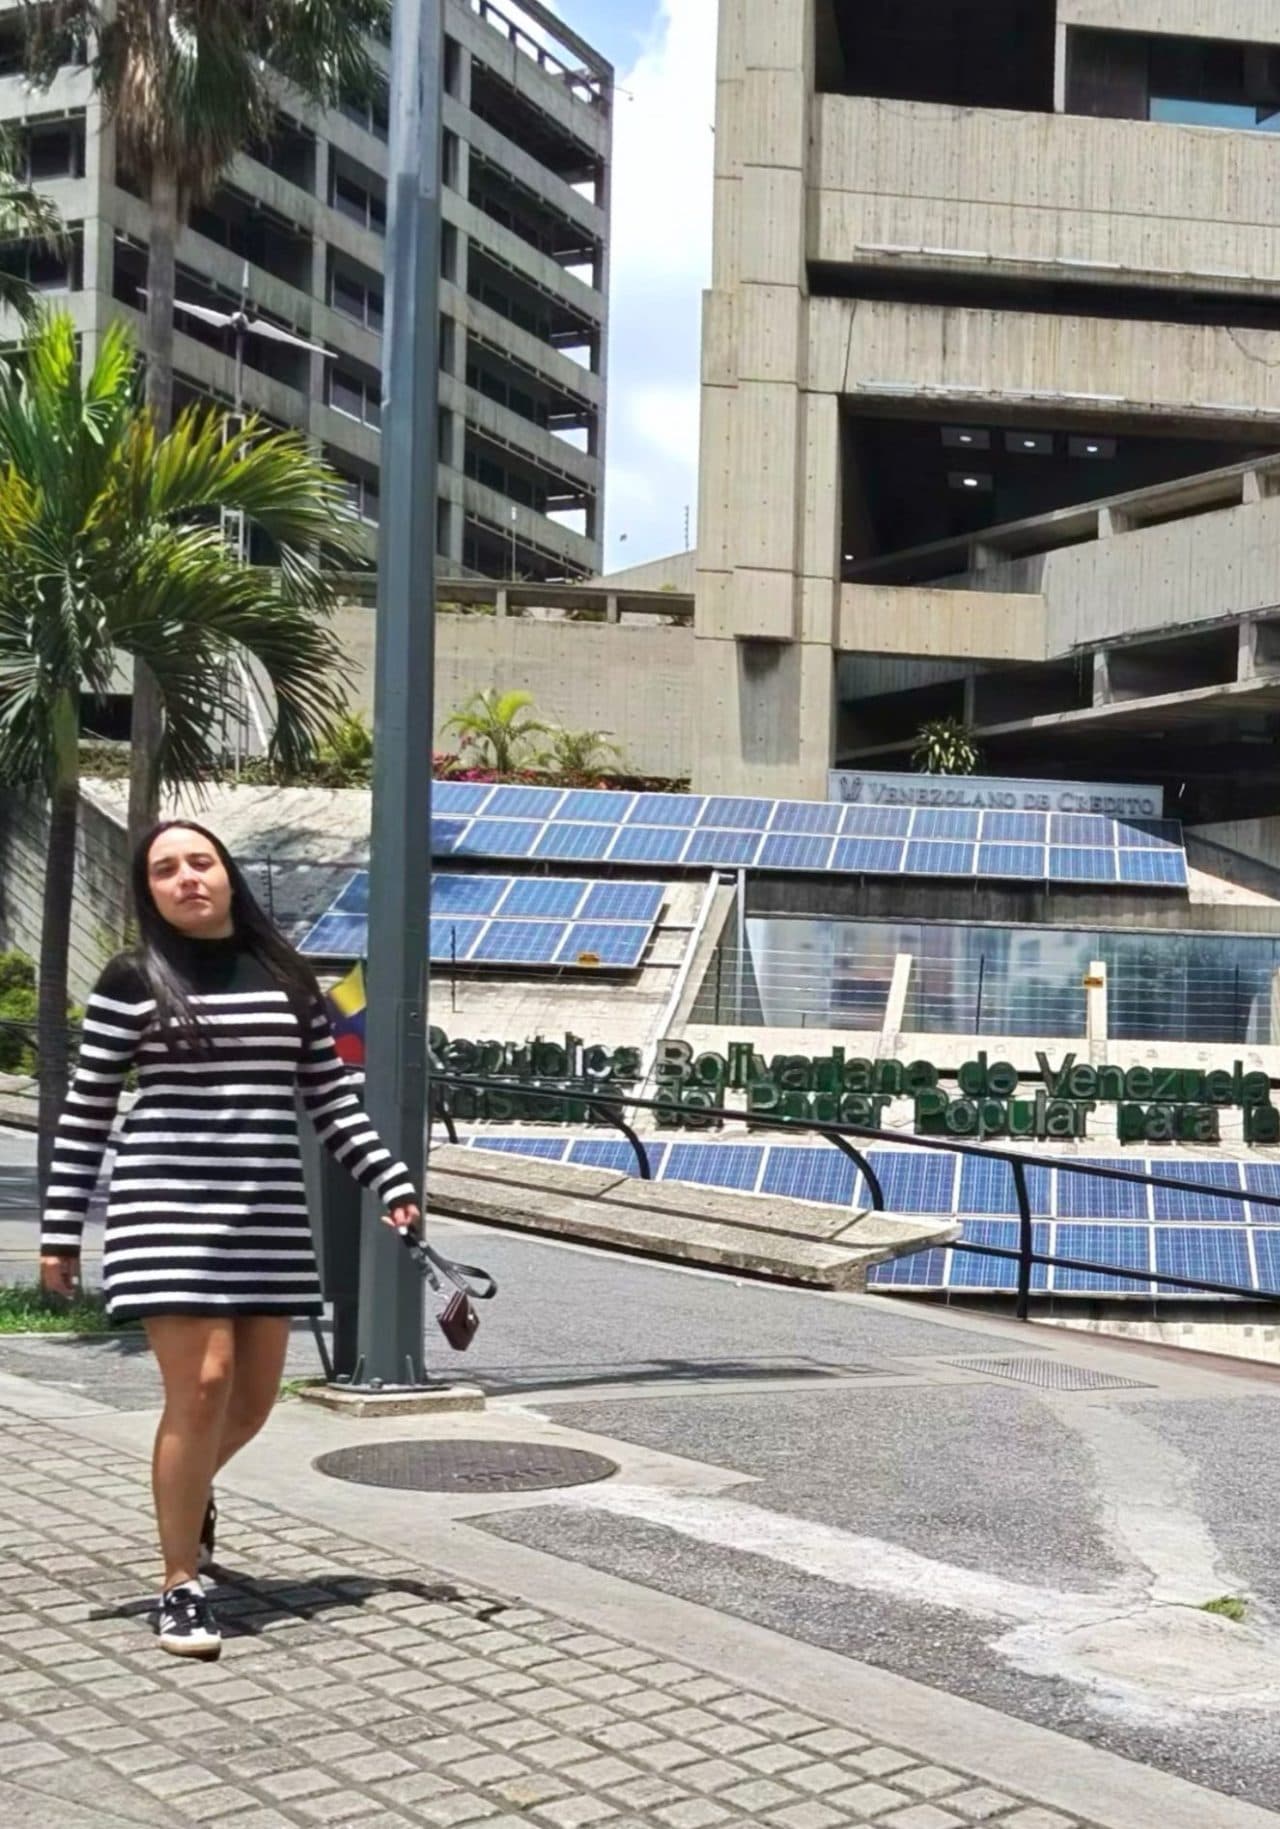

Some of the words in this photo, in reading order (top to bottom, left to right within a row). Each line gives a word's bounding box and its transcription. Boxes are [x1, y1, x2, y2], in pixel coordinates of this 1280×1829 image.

[656, 1039, 938, 1097] Bolivariana
[958, 1051, 1019, 1098] de
[1035, 1051, 1270, 1106] Venezuela
[914, 1088, 1096, 1141] Popular
[1117, 1104, 1222, 1145] para
